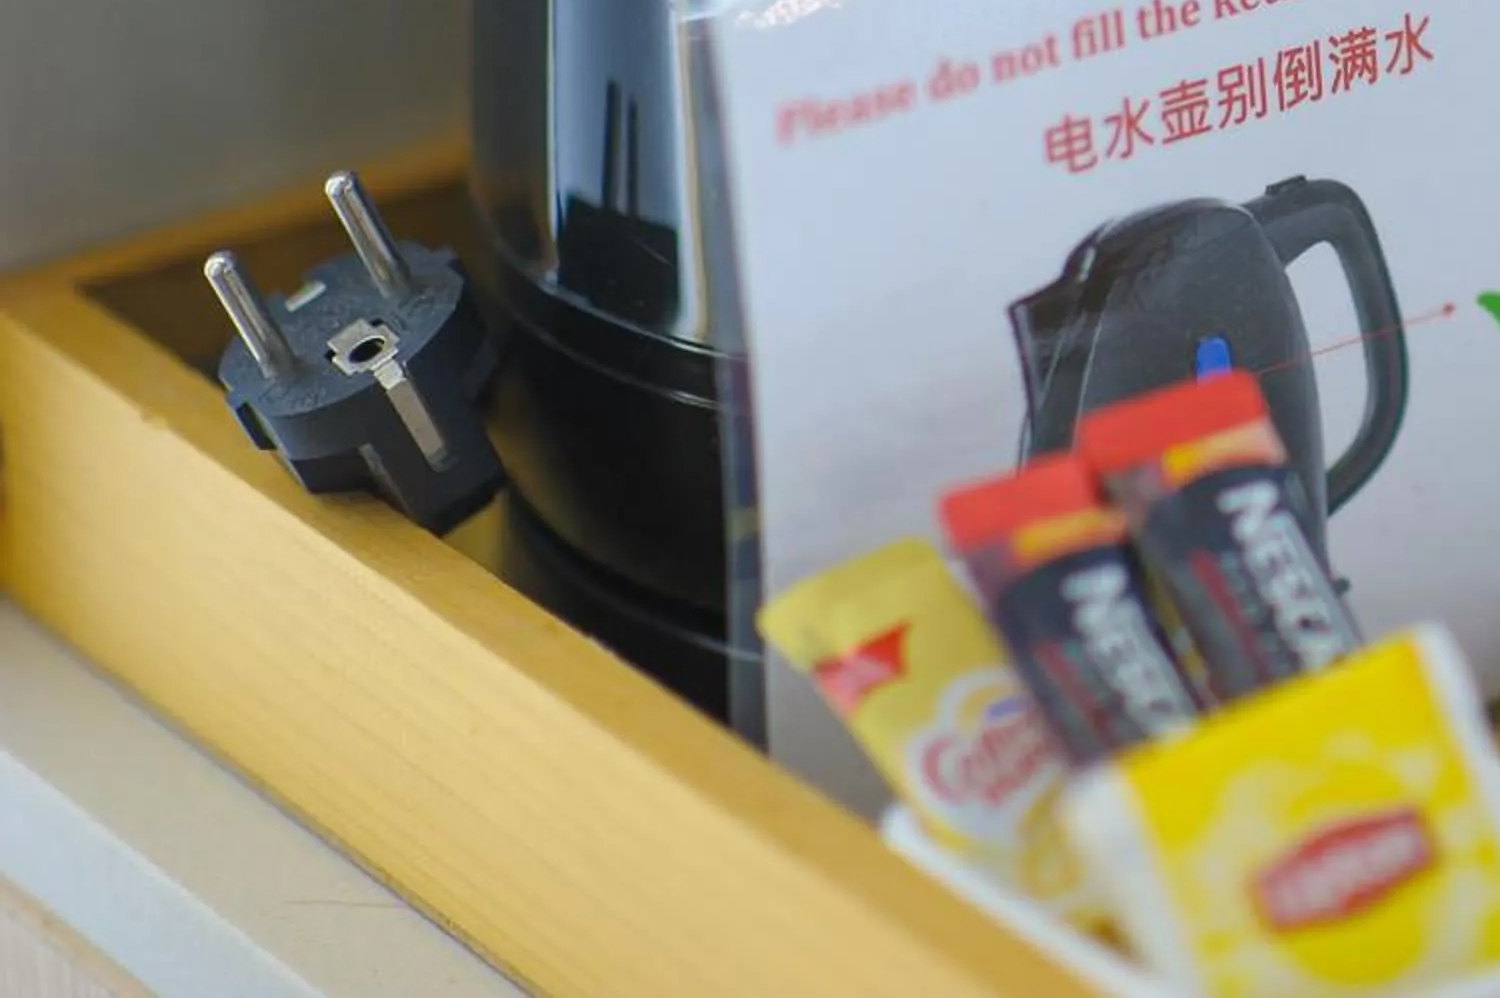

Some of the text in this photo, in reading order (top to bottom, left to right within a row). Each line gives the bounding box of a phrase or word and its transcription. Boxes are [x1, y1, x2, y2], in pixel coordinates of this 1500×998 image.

[777, 81, 916, 147] Please
[928, 56, 980, 102] do
[992, 34, 1060, 82] not
[1071, 8, 1126, 61] fill
[1042, 12, 1435, 176] 电水壶别倒满水
